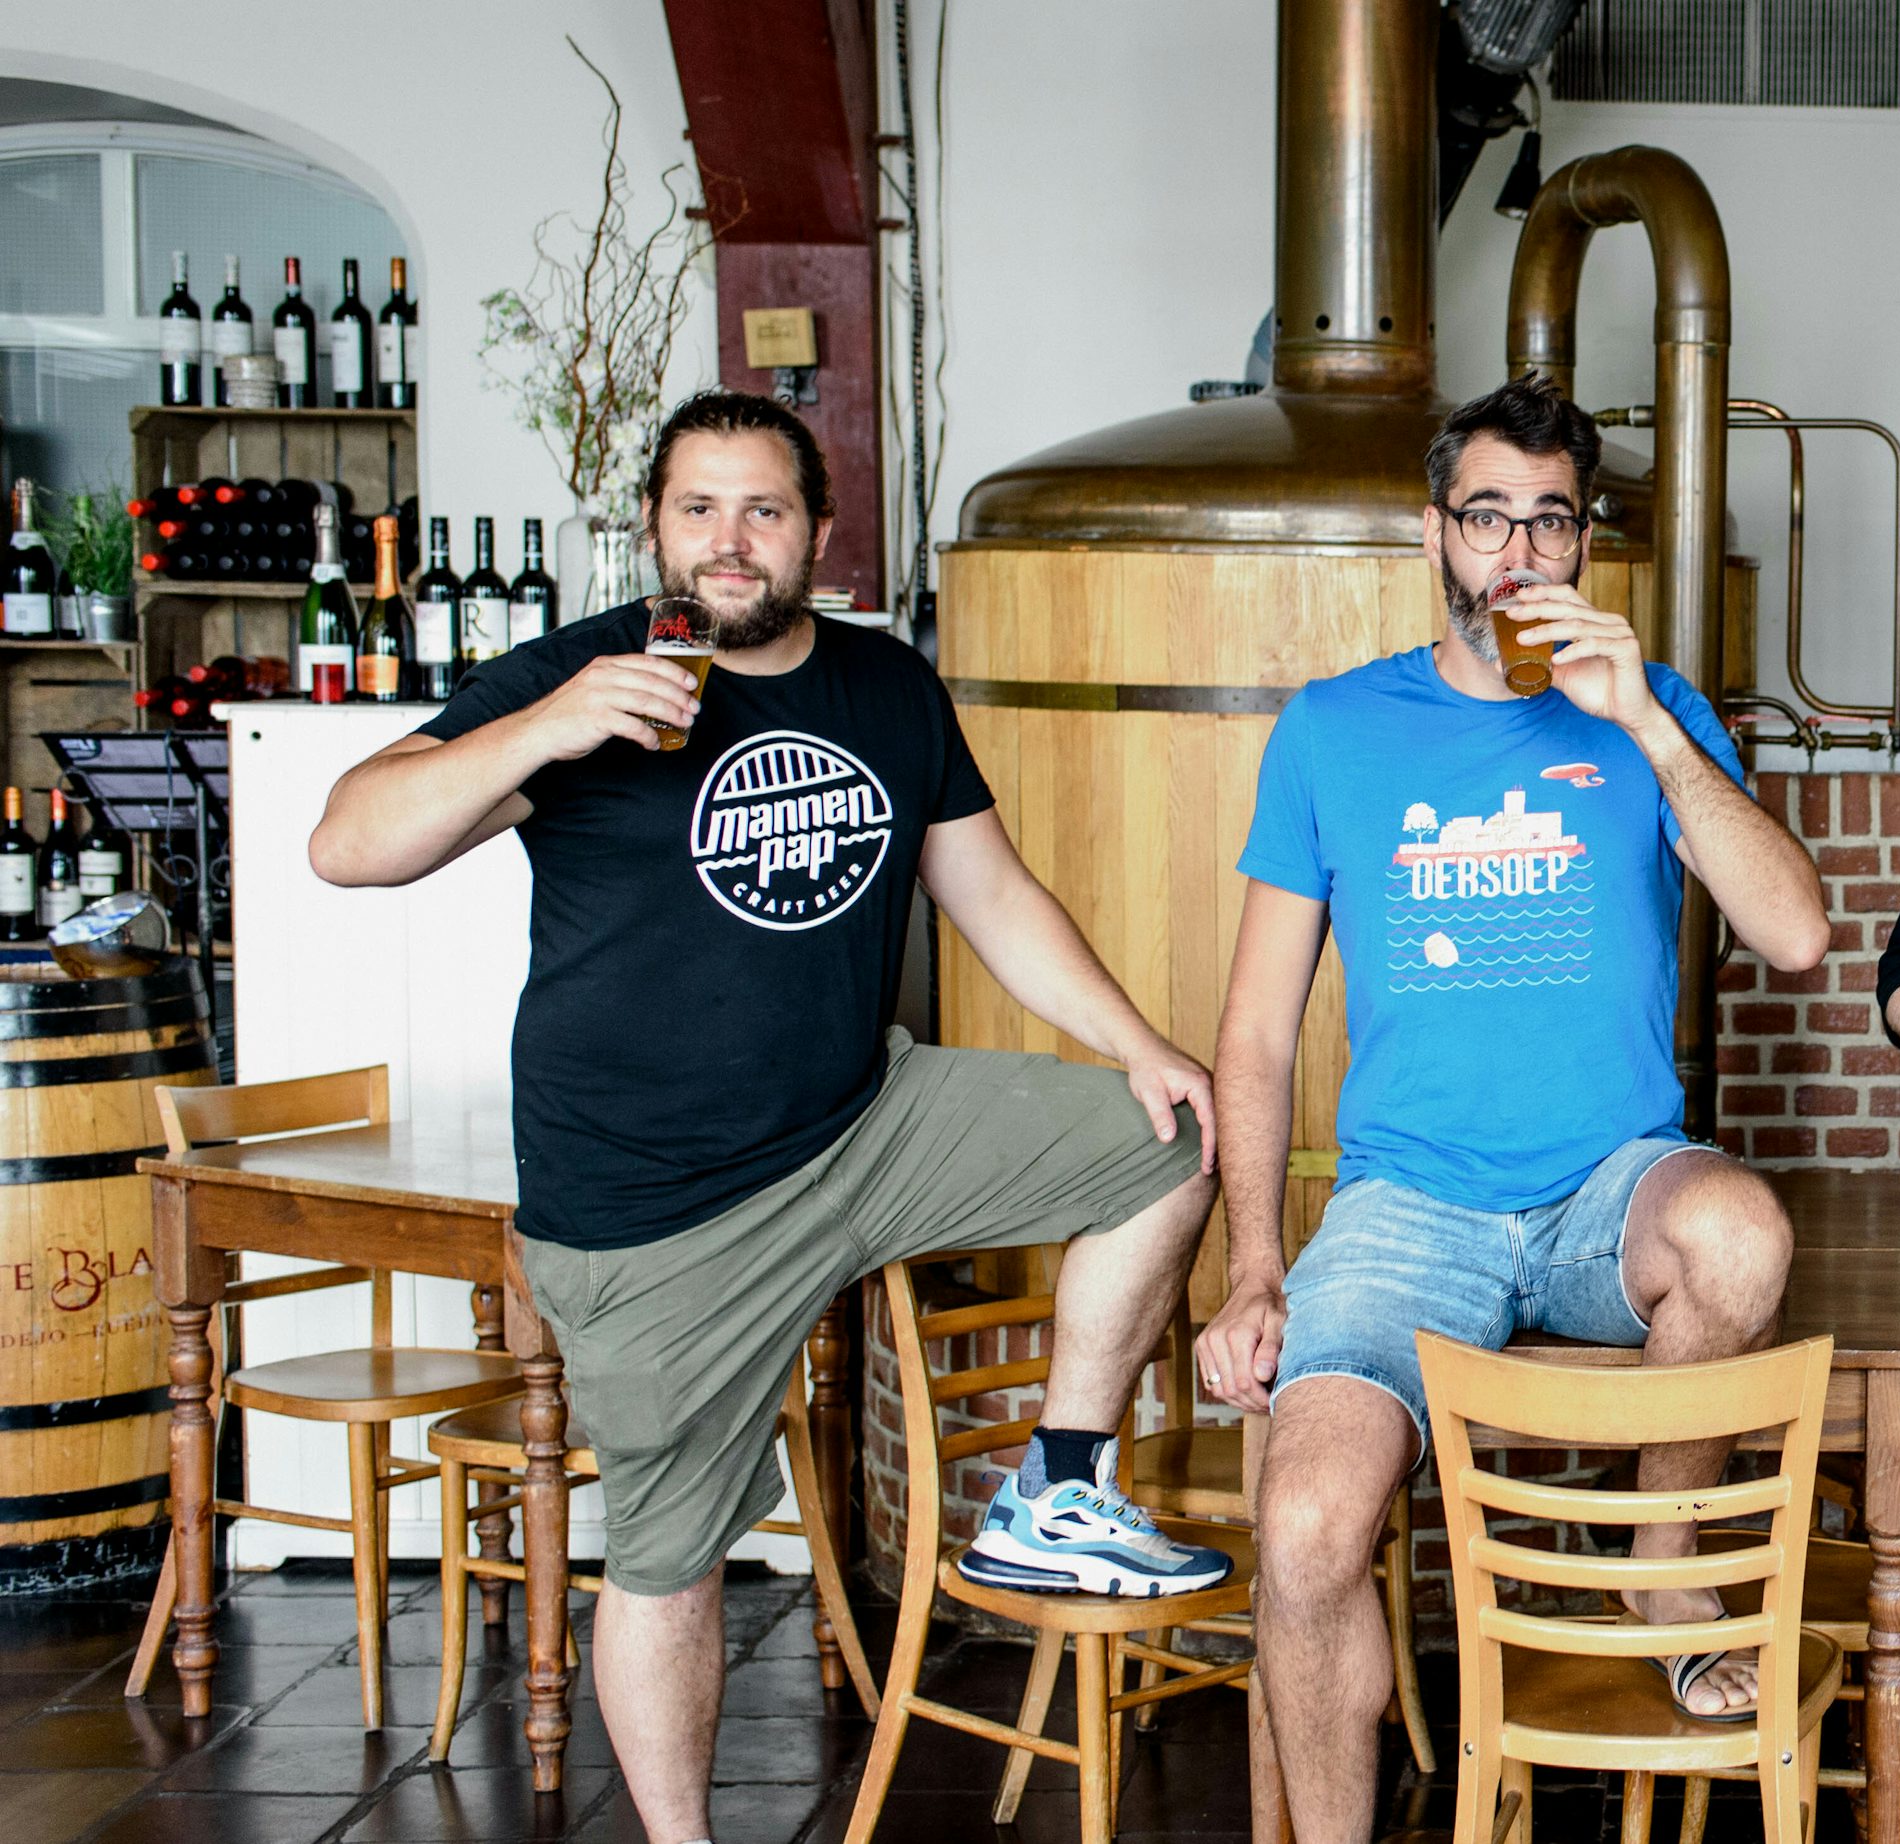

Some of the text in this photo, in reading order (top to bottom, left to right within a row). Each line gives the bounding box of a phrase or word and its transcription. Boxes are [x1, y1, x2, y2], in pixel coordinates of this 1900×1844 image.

[463, 603, 491, 637] R
[704, 784, 886, 855] mannen
[758, 829, 836, 888] pap
[1411, 850, 1570, 901] OERSOEP
[732, 862, 864, 915] CRAFT BEER
